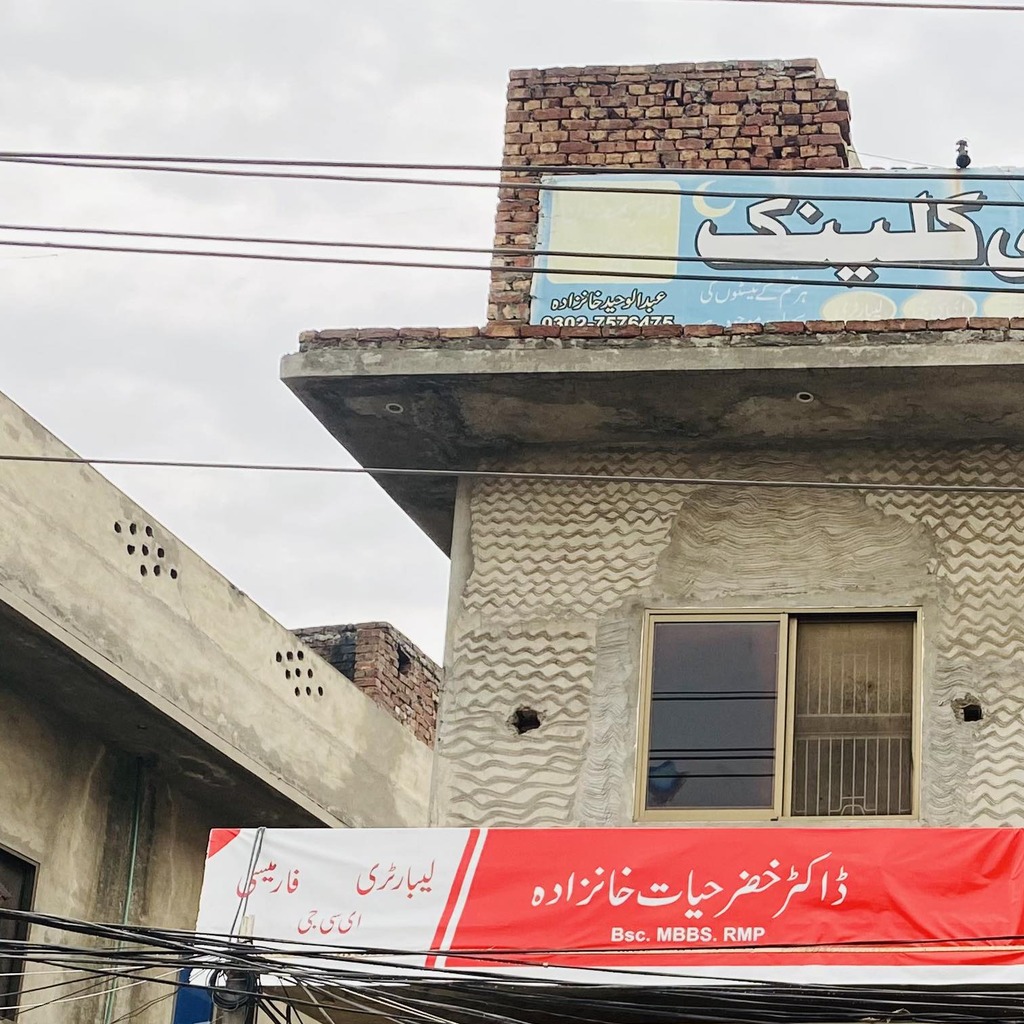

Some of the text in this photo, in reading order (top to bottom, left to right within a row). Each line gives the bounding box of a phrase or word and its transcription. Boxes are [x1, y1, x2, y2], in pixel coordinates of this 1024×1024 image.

[531, 851, 849, 920] ڈاکٹر خضر حیات خانزادہ
[611, 927, 766, 942] Bsc. MBBS. RMP
